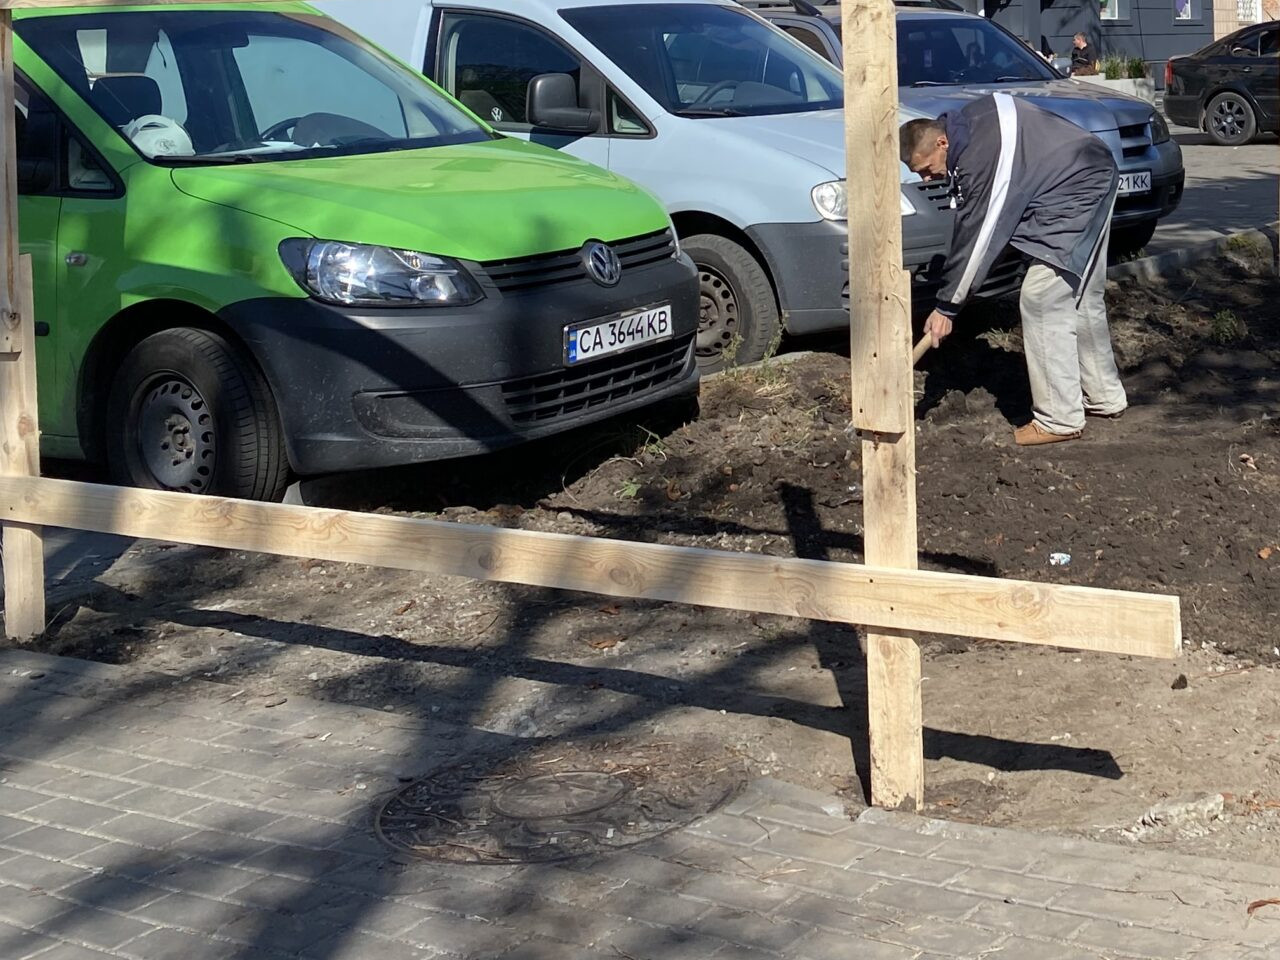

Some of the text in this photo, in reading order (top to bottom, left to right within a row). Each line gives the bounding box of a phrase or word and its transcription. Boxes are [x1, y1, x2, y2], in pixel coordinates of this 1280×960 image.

[580, 311, 668, 353] CA 3644 KB
